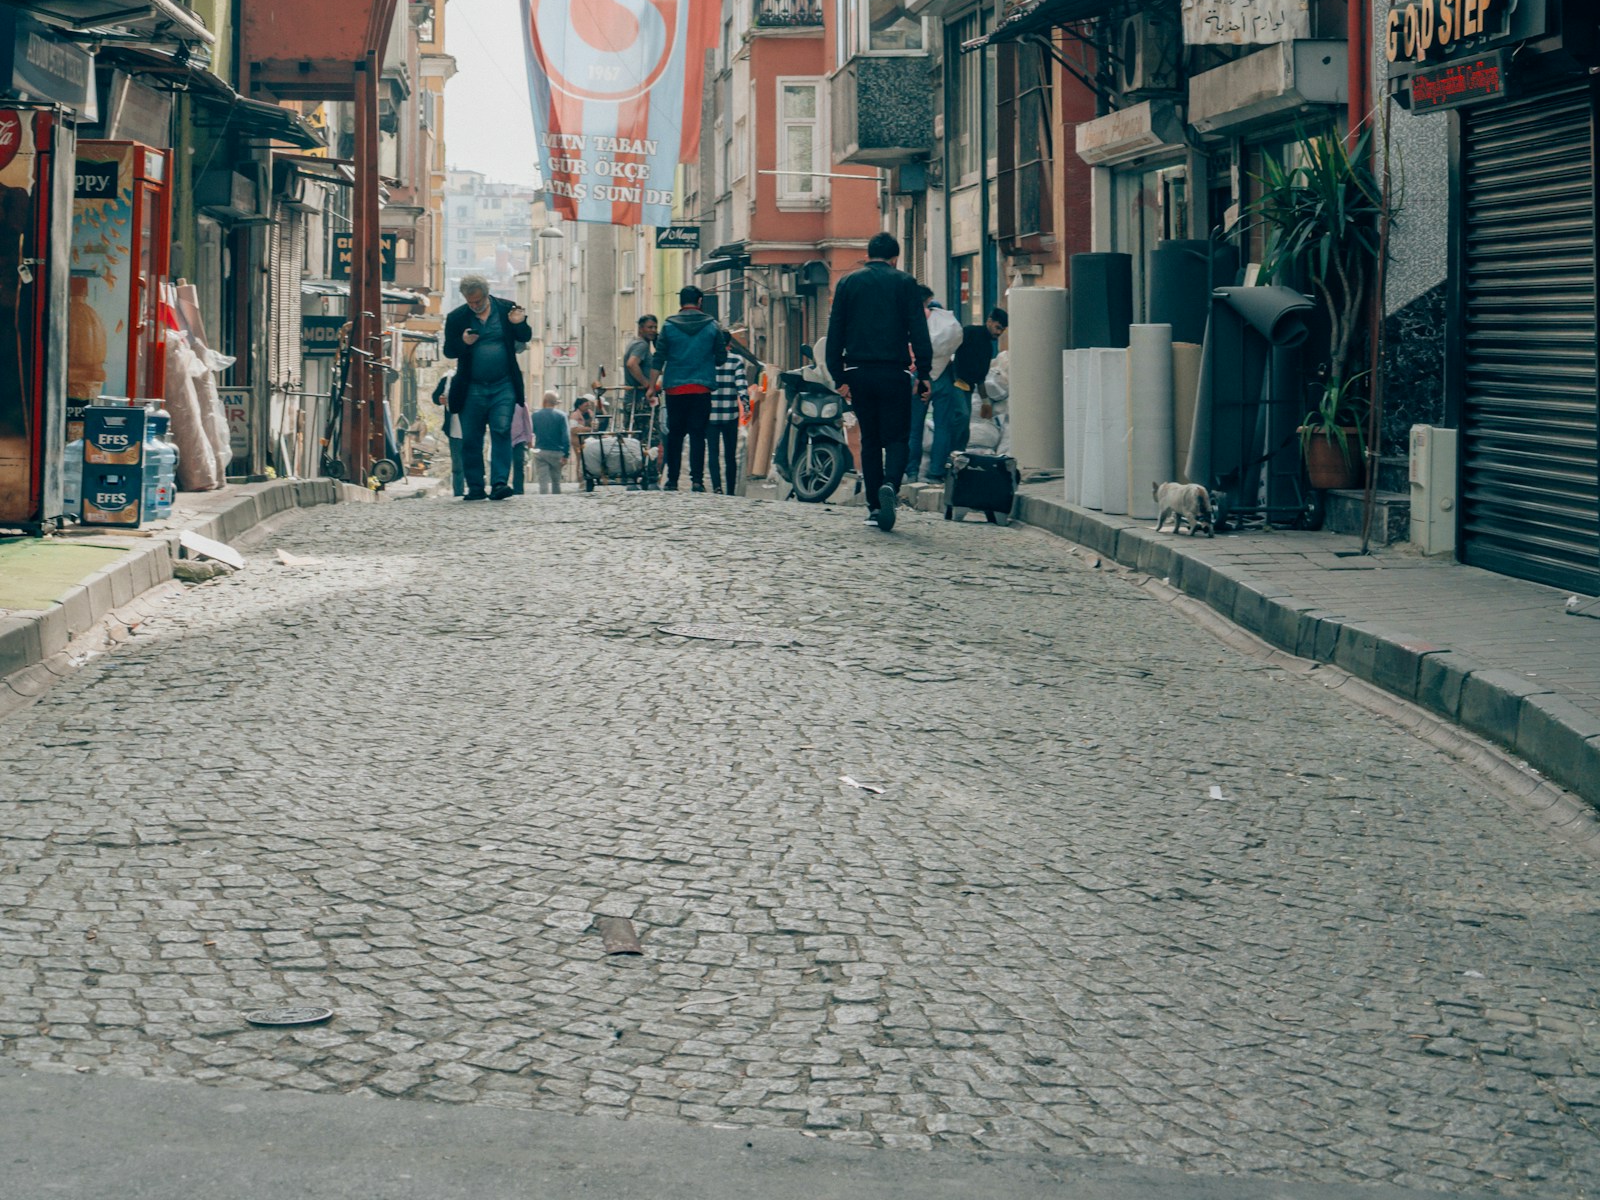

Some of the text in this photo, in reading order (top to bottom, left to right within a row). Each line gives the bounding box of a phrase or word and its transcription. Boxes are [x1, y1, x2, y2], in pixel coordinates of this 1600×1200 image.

[593, 135, 658, 156] TABAN
[547, 153, 650, 182] GÜR ÖKÇE
[543, 179, 587, 202] ATAŞ
[593, 184, 640, 203] SUNİ
[98, 434, 129, 445] EFES
[96, 492, 127, 504] EFES
